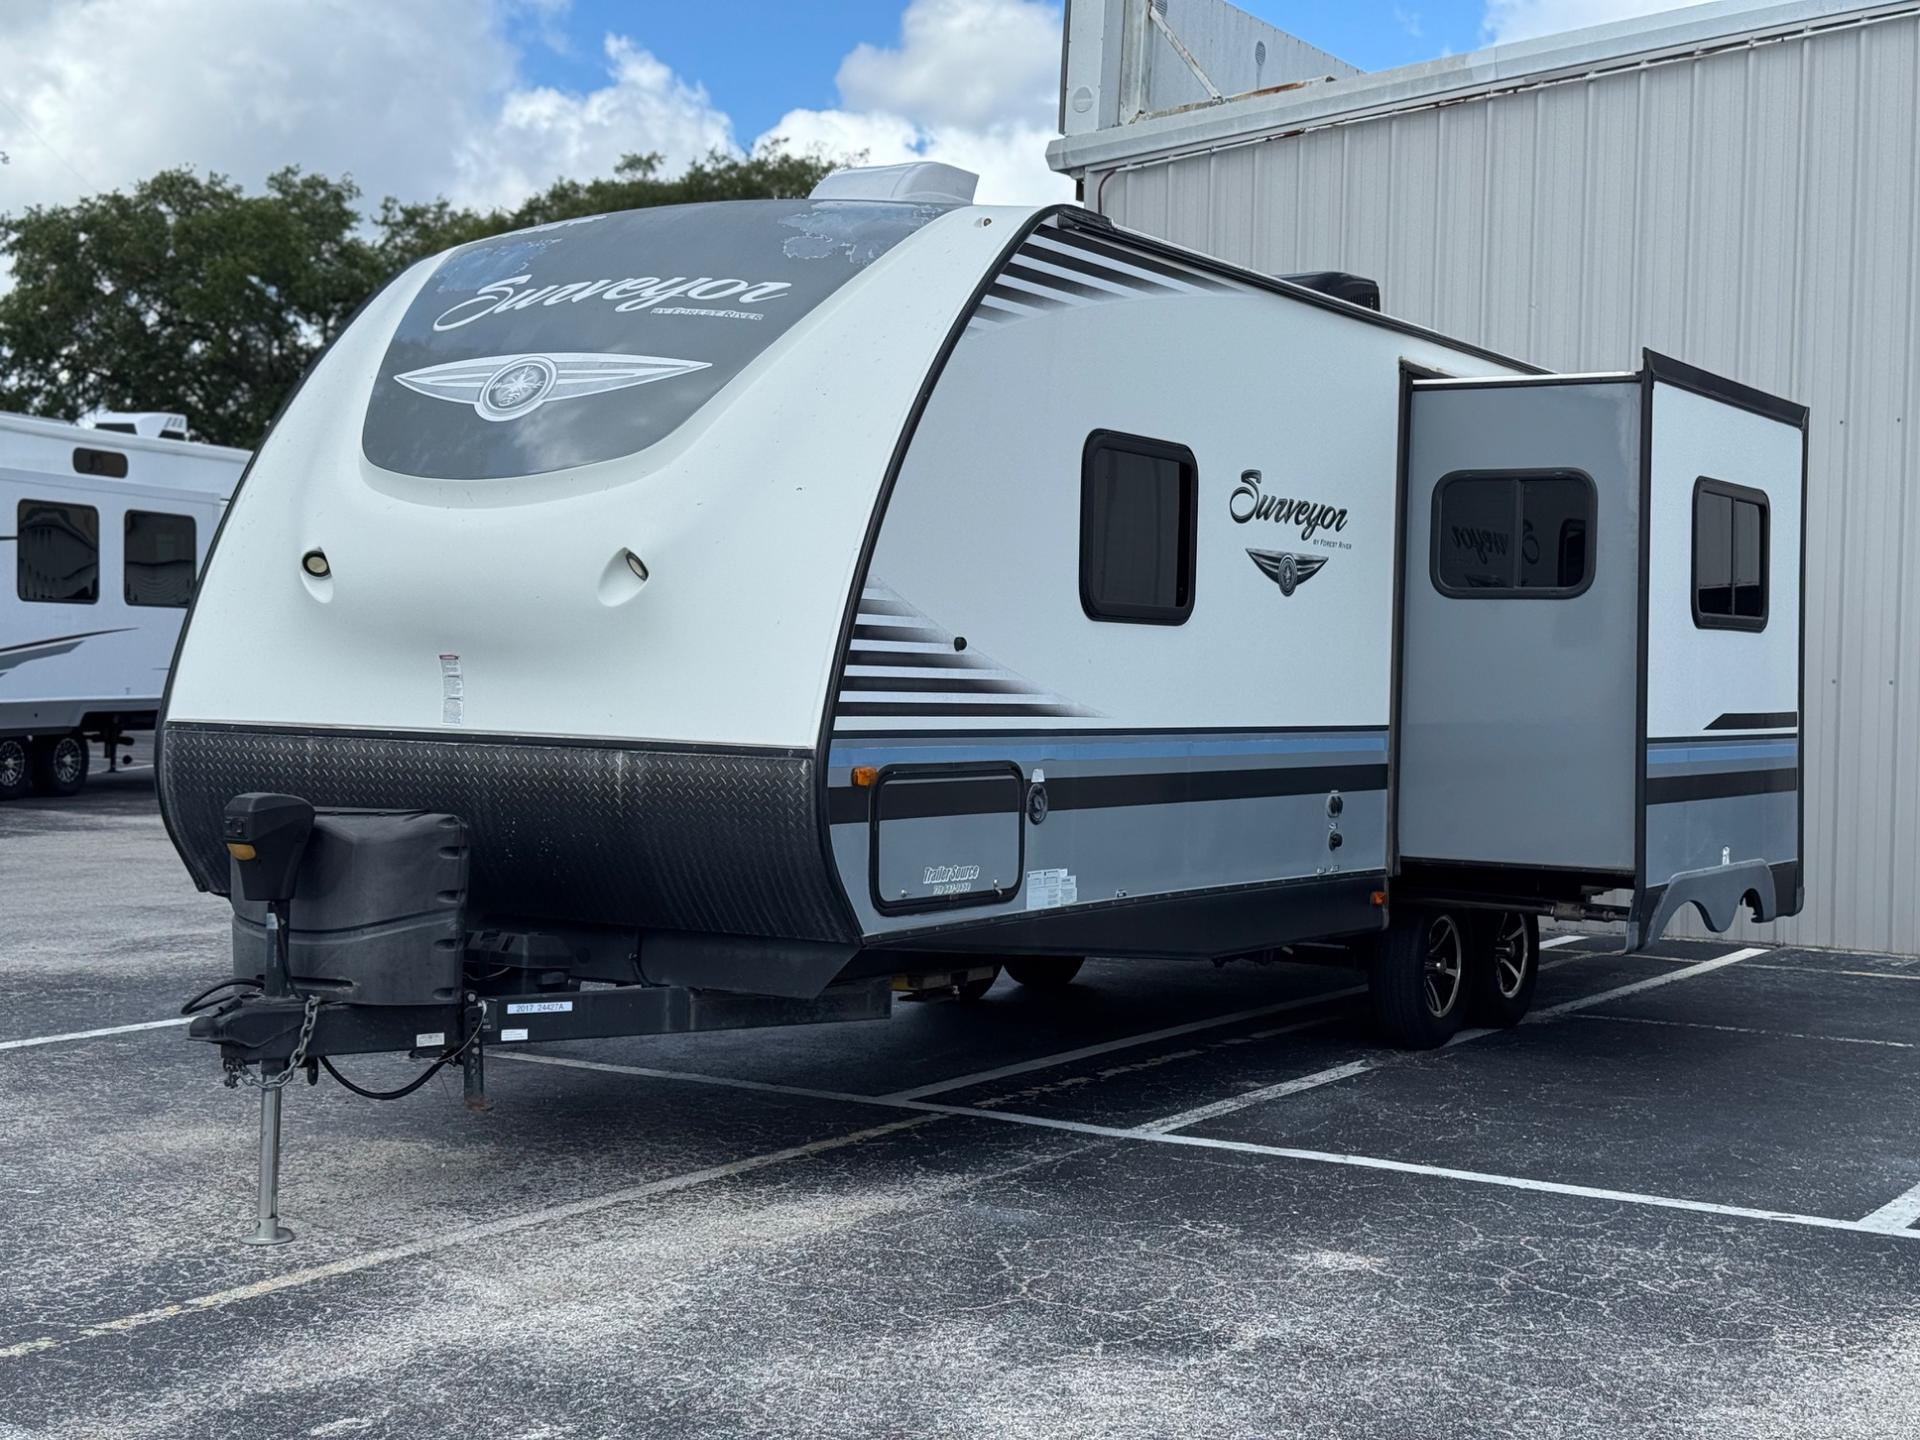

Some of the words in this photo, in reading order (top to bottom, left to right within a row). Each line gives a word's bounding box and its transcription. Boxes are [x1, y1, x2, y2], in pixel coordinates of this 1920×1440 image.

[433, 274, 792, 331] Surveyor
[1229, 468, 1348, 541] Surveyor
[516, 1004, 534, 1013] 2017
